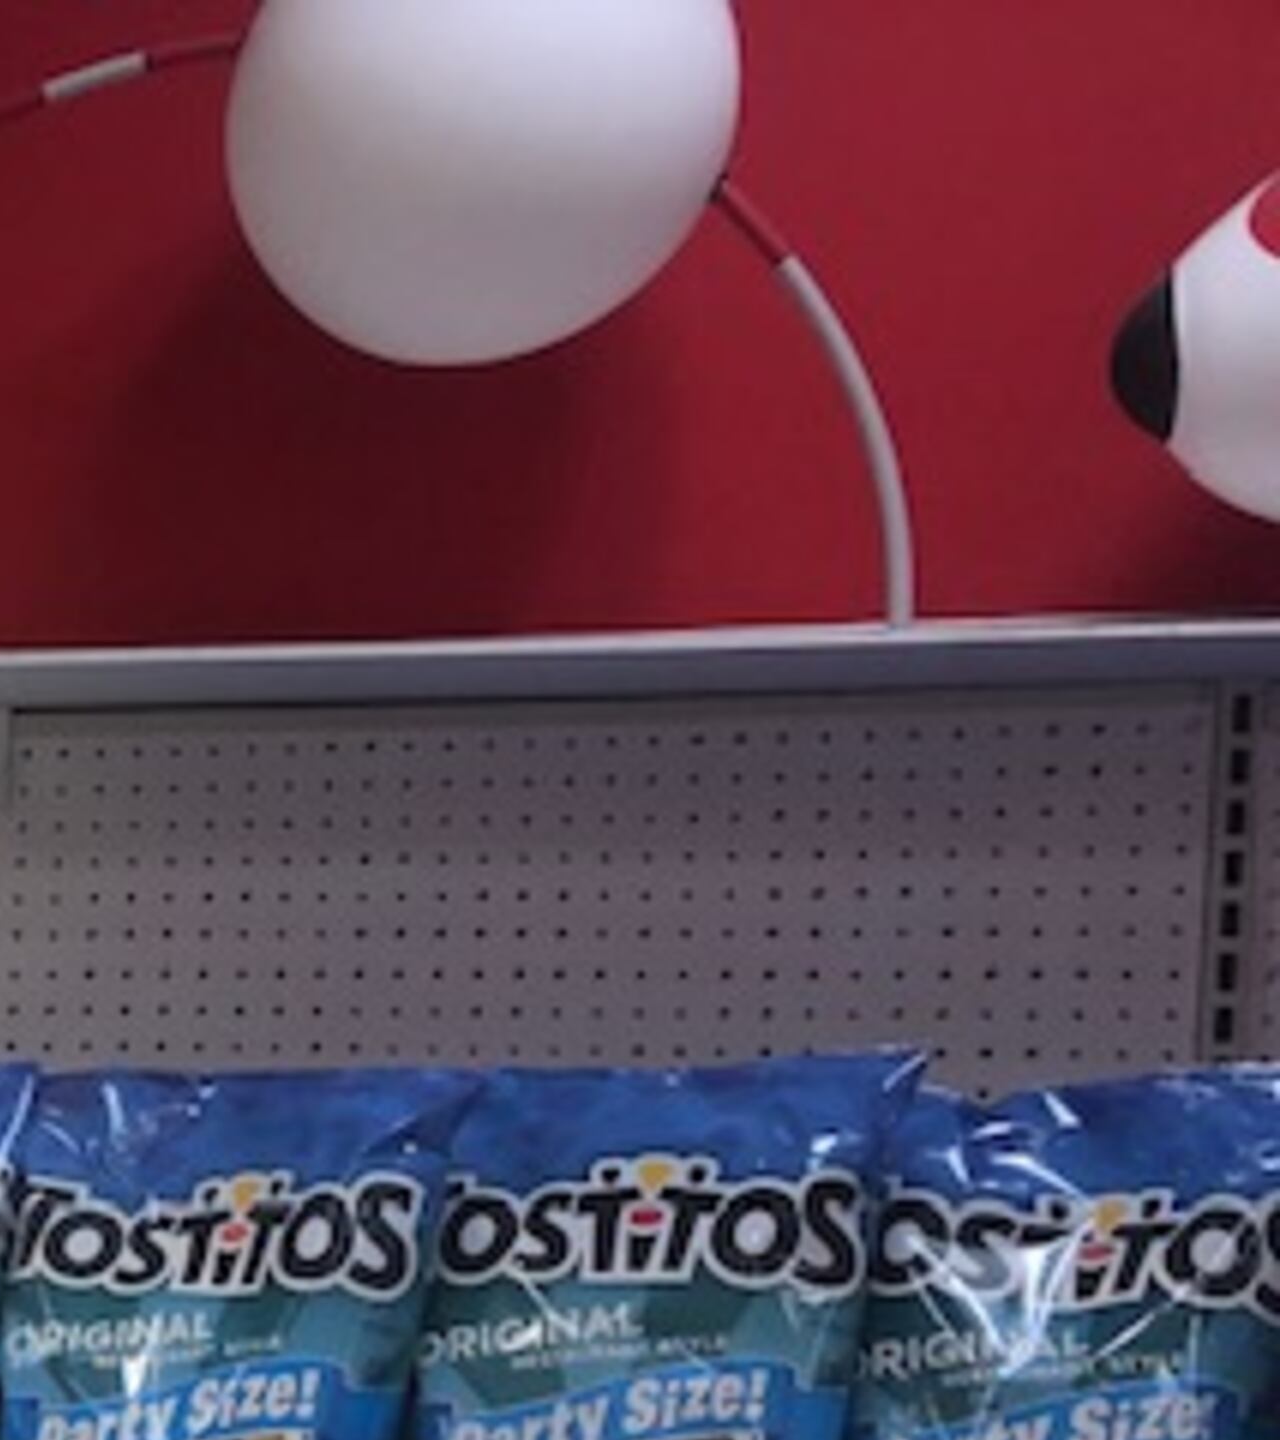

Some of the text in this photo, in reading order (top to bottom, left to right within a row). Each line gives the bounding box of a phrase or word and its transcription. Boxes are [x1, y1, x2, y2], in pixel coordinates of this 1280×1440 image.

[438, 1153, 865, 1302] OSTITOS
[6, 1311, 214, 1366] ORIGINAL
[860, 1330, 1092, 1382] RIGINAL
[186, 1368, 322, 1433] Size!
[621, 1367, 770, 1434] Size!
